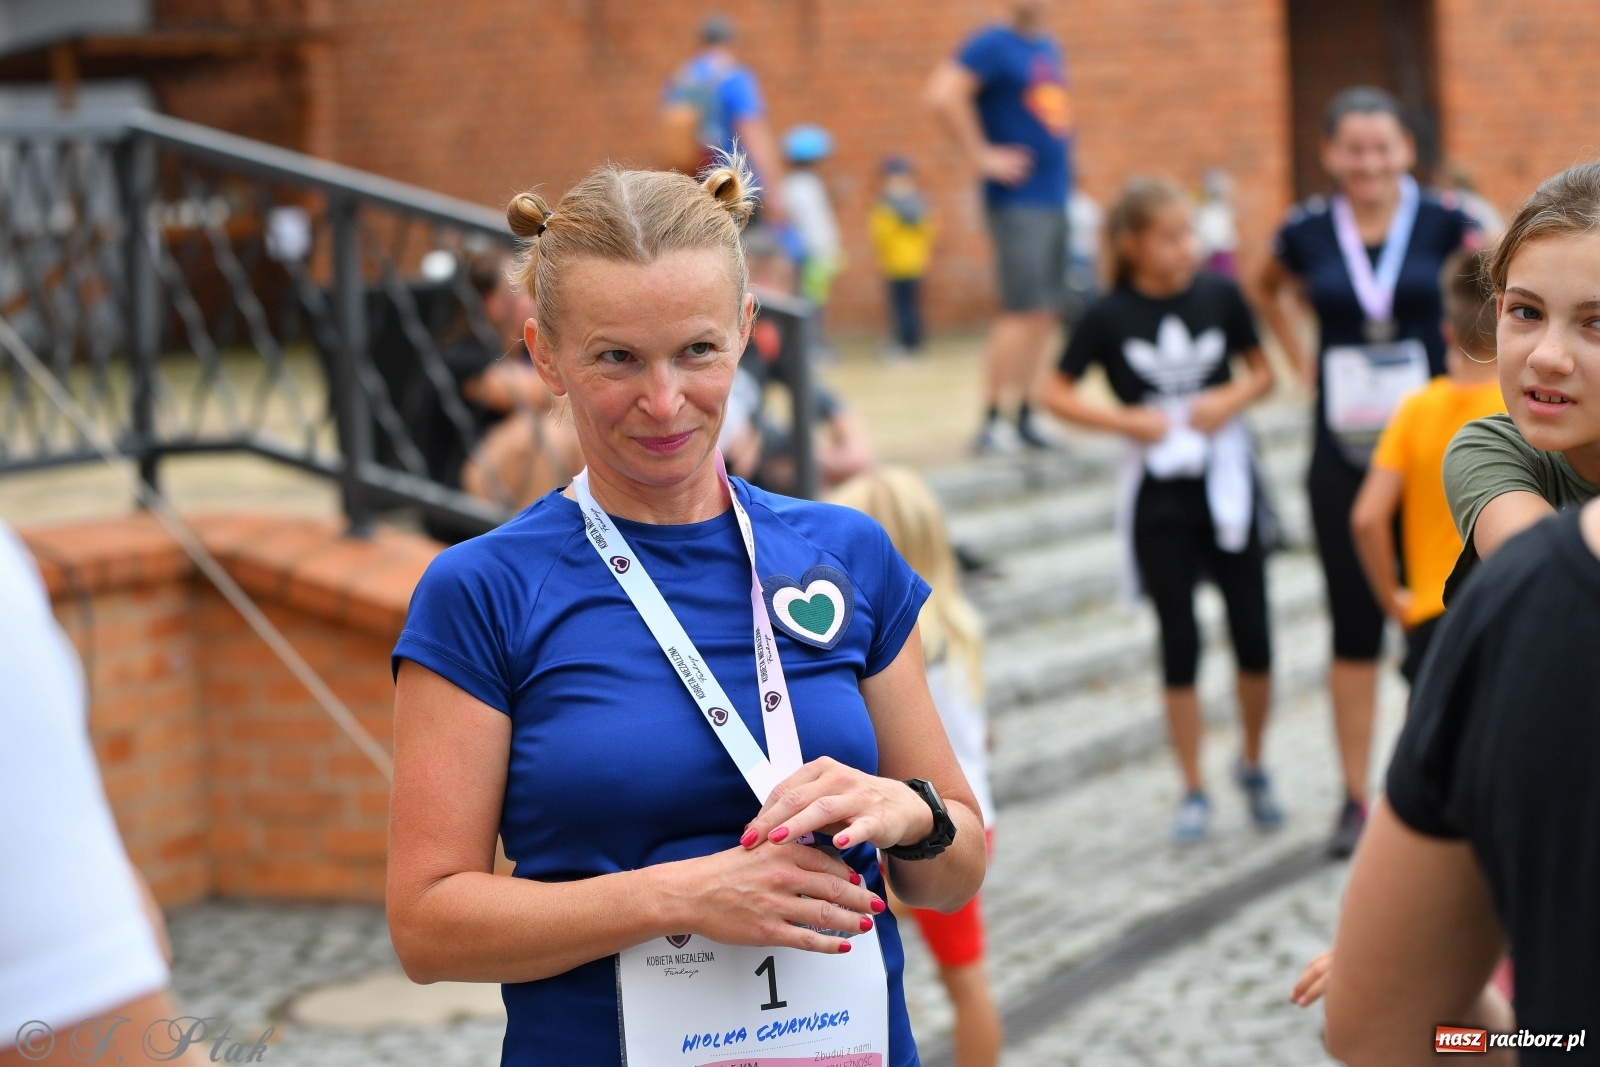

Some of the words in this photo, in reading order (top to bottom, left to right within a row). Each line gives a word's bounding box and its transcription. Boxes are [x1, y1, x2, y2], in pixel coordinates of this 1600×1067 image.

[590, 527, 608, 549] KOBIETA
[687, 677, 706, 699] KOBIETA
[646, 954, 674, 967] KOBIETA
[675, 950, 715, 965] NIEZALEŻNA
[755, 955, 787, 1011] 1
[682, 1026, 747, 1054] WIOLKA
[814, 1046, 844, 1062] Zbuduj
[847, 1047, 851, 1056] z
[853, 1040, 872, 1053] nami
